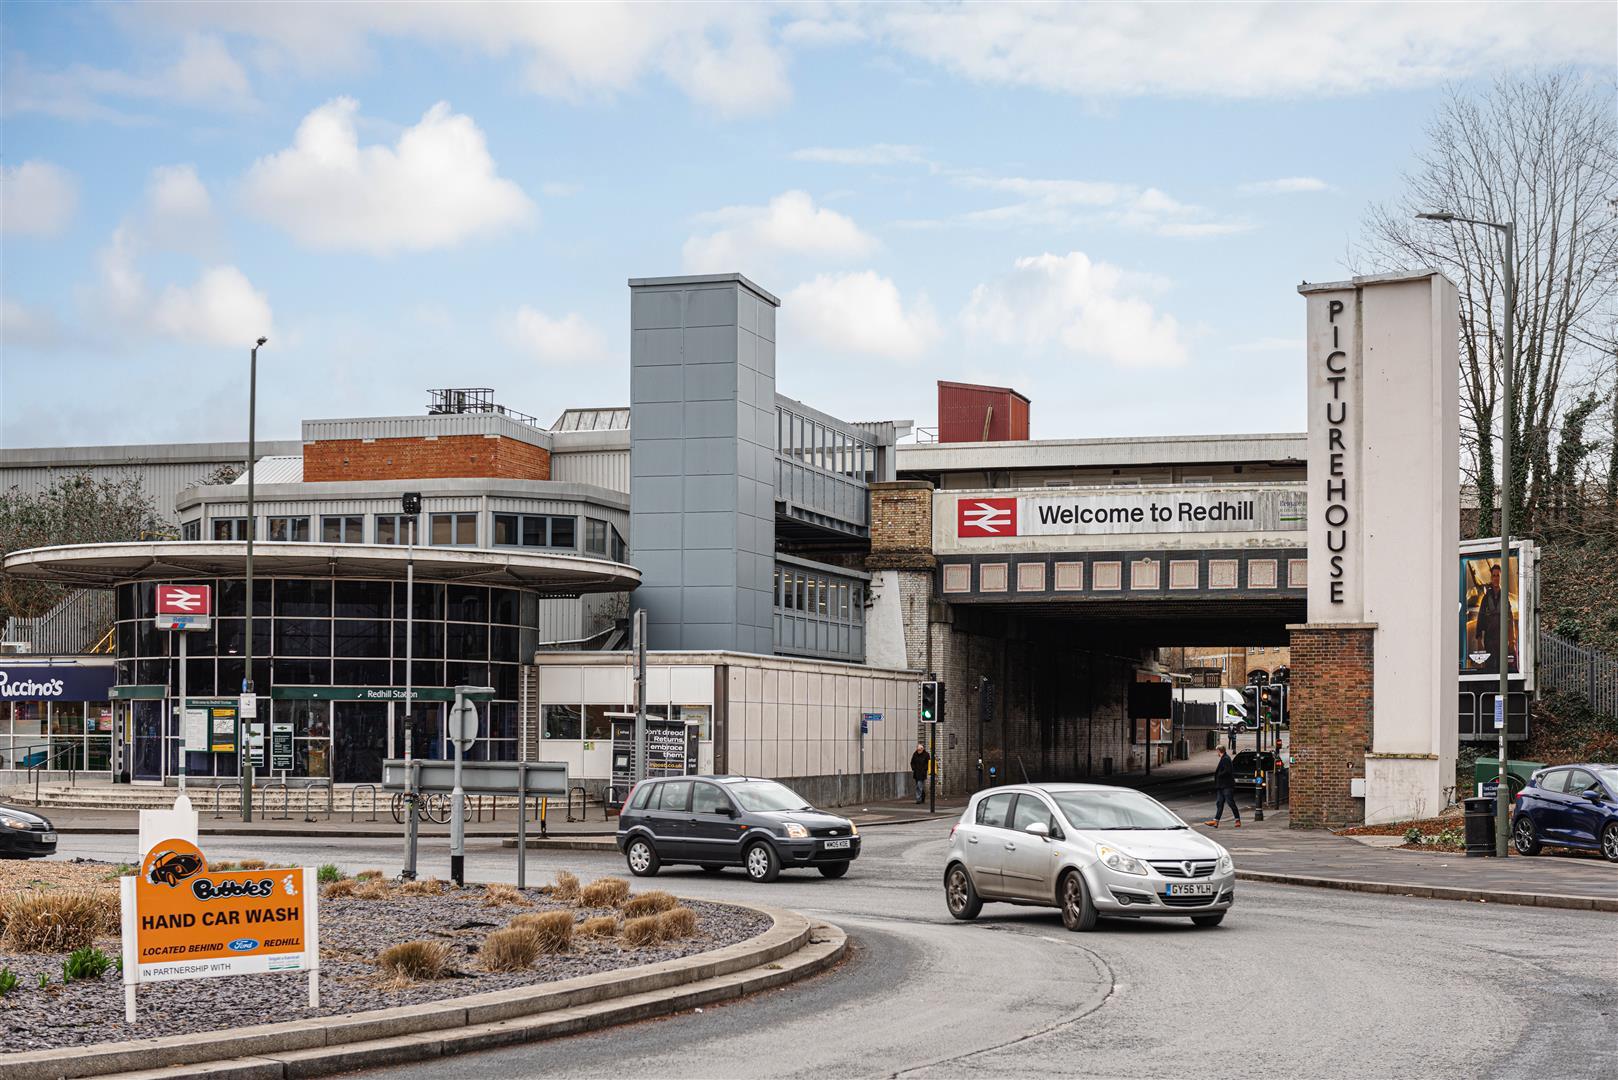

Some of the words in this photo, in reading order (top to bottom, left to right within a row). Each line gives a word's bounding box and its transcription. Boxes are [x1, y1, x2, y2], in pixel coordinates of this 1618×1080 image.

[1325, 300, 1348, 604] PICTUREHOUSE
[1039, 505, 1144, 525] Welcome
[1150, 503, 1172, 522] to
[1178, 501, 1254, 522] Redhill
[367, 690, 392, 698] Redhill
[1172, 885, 1195, 894] GY56
[1196, 884, 1211, 894] YLH
[142, 913, 196, 930] HAND
[202, 910, 240, 926] CAR
[245, 907, 299, 923] WASH
[143, 945, 186, 956] LOCATED
[188, 943, 224, 953] BEHIND
[263, 937, 300, 947] REDHILL
[143, 969, 151, 977] IN
[153, 965, 209, 975] PARTNERSHIP
[211, 963, 231, 971] WITH
